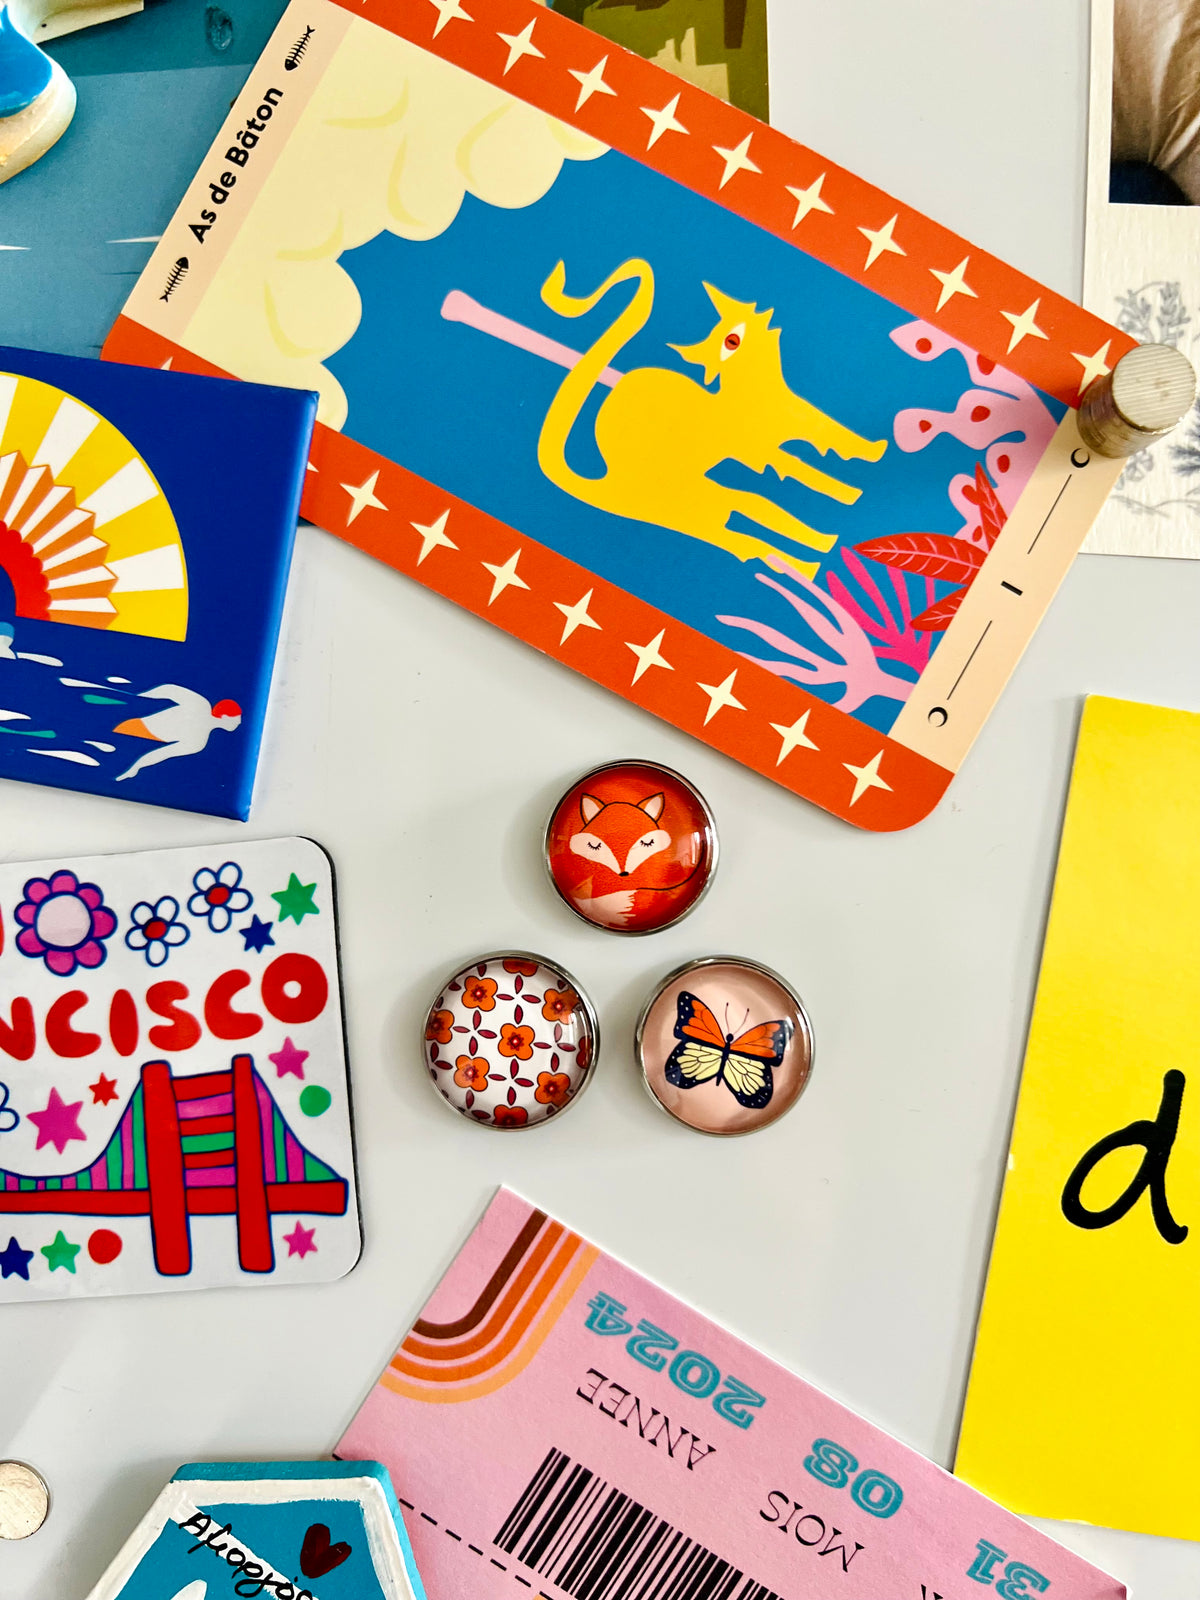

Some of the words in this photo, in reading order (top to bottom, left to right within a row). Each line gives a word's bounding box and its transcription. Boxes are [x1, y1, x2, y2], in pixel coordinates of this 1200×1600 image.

[188, 208, 217, 244] As
[208, 171, 237, 205] de
[224, 86, 284, 168] Bâton
[1060, 1068, 1189, 1245] d
[575, 1367, 717, 1472] ANNEE
[583, 1290, 767, 1431] 2024
[759, 1490, 866, 1573] MOIS
[802, 1437, 904, 1519] 08
